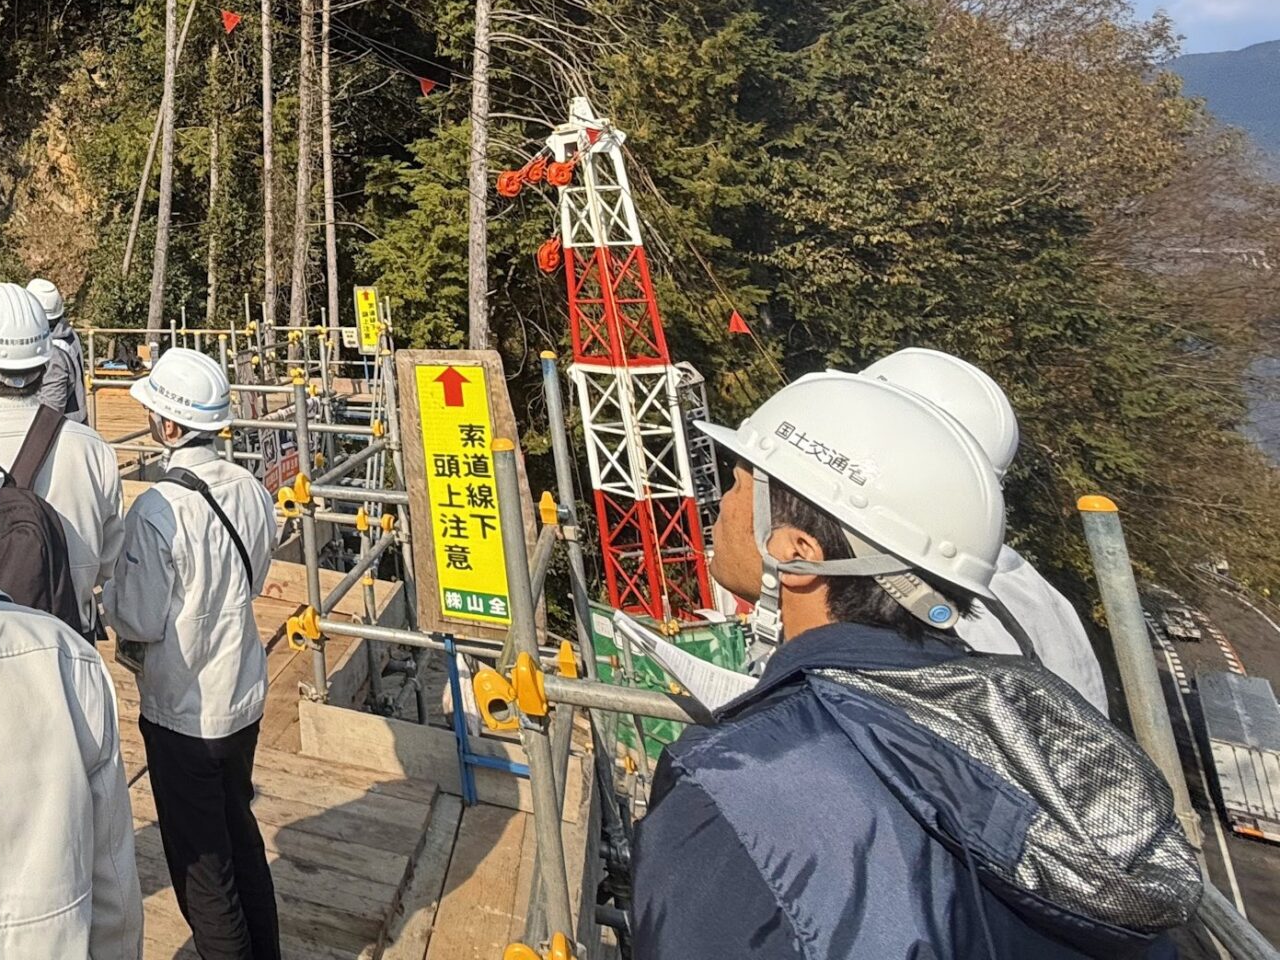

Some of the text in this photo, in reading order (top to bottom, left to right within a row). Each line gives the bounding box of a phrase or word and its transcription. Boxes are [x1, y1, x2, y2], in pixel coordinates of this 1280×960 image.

[458, 423, 497, 539] 索道線下
[775, 421, 868, 486] 国土交通省
[432, 453, 473, 571] 頭上注意
